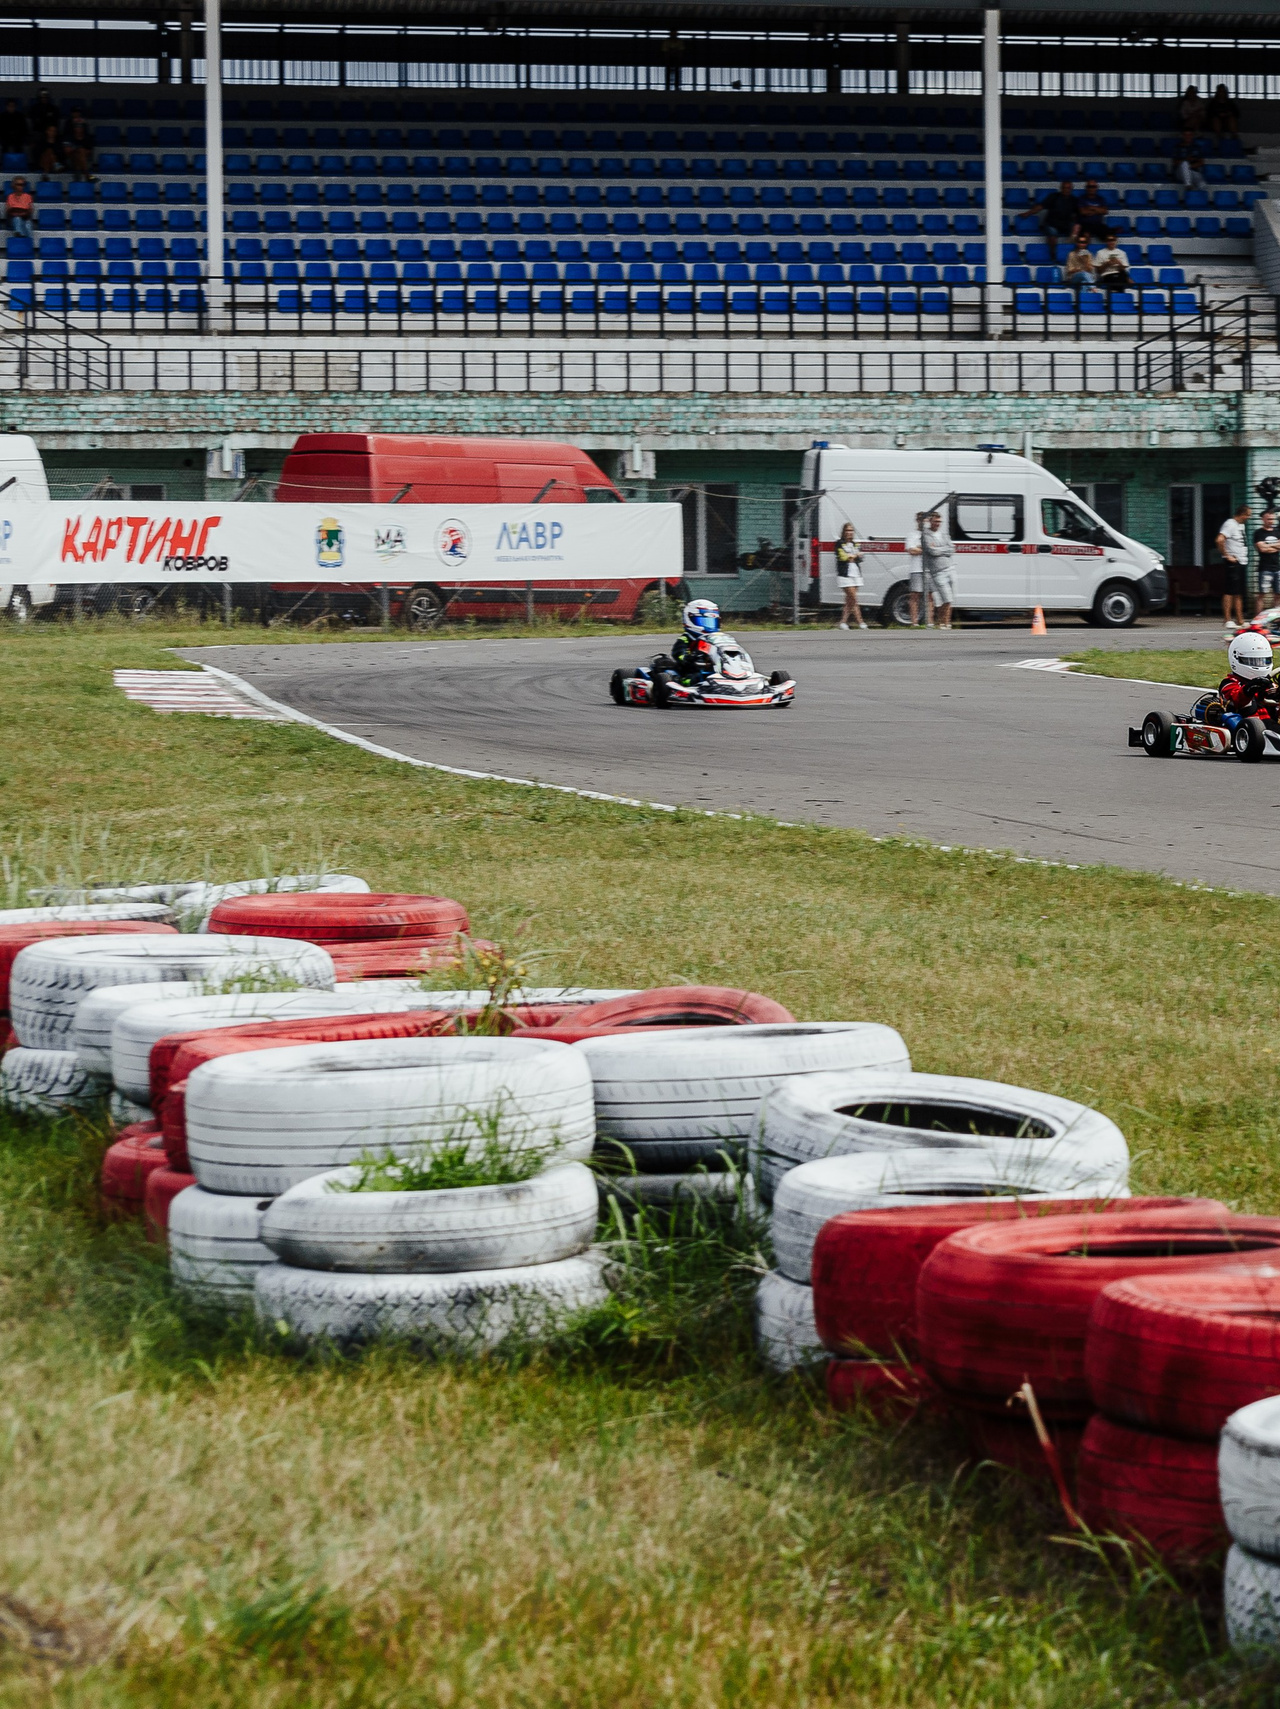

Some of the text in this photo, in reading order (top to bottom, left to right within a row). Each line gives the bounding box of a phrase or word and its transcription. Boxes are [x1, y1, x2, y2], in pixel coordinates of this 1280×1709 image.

[61, 515, 223, 564] КАРТИНГ
[496, 521, 563, 549] ЛАВР
[163, 556, 229, 571] КОВРОВ
[1175, 727, 1183, 749] 2
